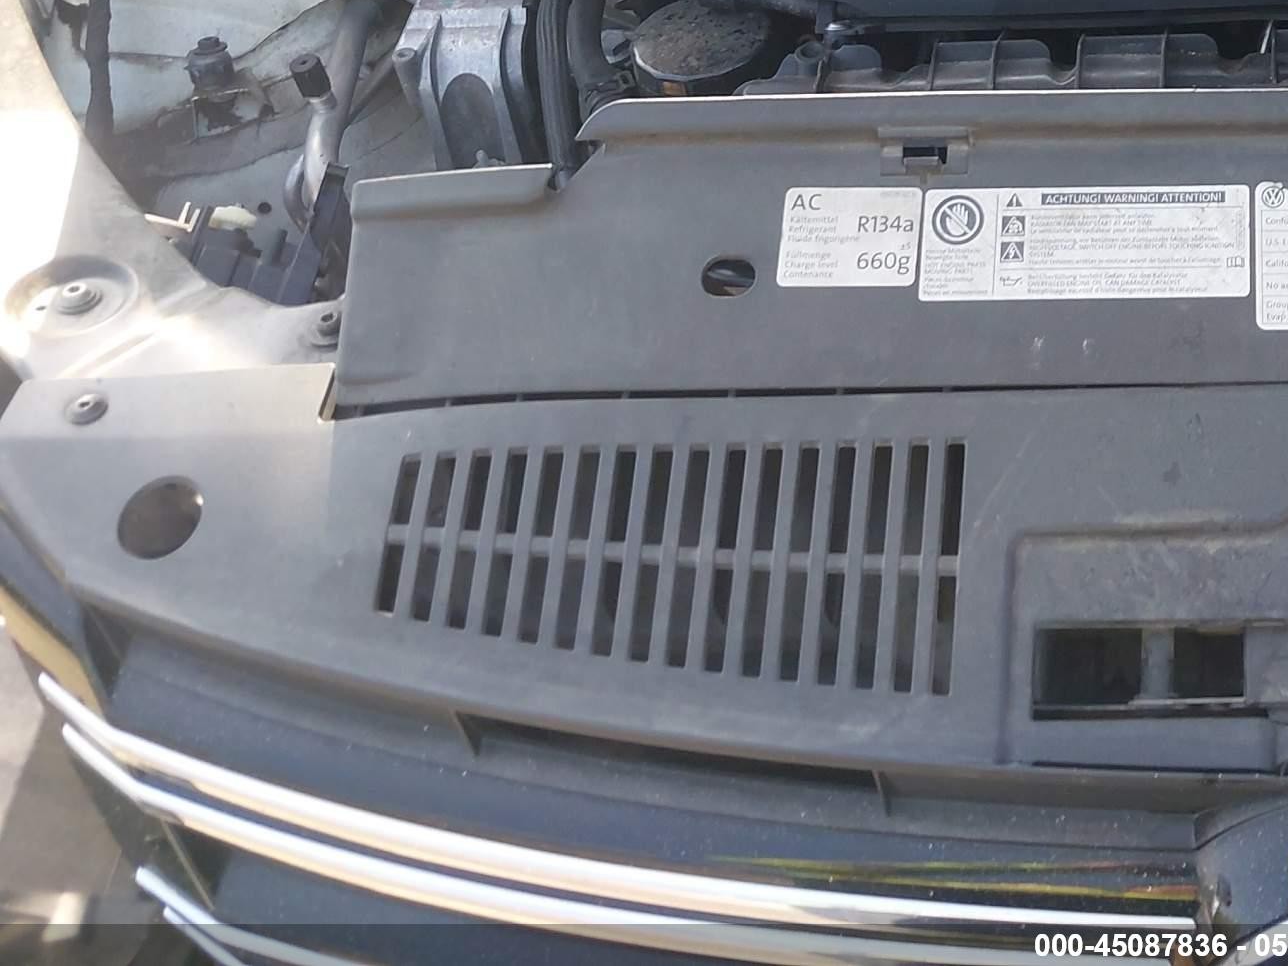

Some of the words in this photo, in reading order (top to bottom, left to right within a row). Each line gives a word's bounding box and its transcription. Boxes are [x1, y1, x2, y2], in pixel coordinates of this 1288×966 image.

[791, 194, 822, 210] AC
[1045, 194, 1101, 204] ACHTUNG!
[1104, 193, 1159, 203] WARNING!
[1161, 192, 1222, 203] ATTENTION!
[857, 215, 914, 233] R134a
[788, 225, 836, 234] Refrigerant
[784, 261, 816, 270] Charge
[857, 252, 911, 275] 660g
[783, 270, 833, 278] Contenance
[1265, 282, 1279, 290] No
